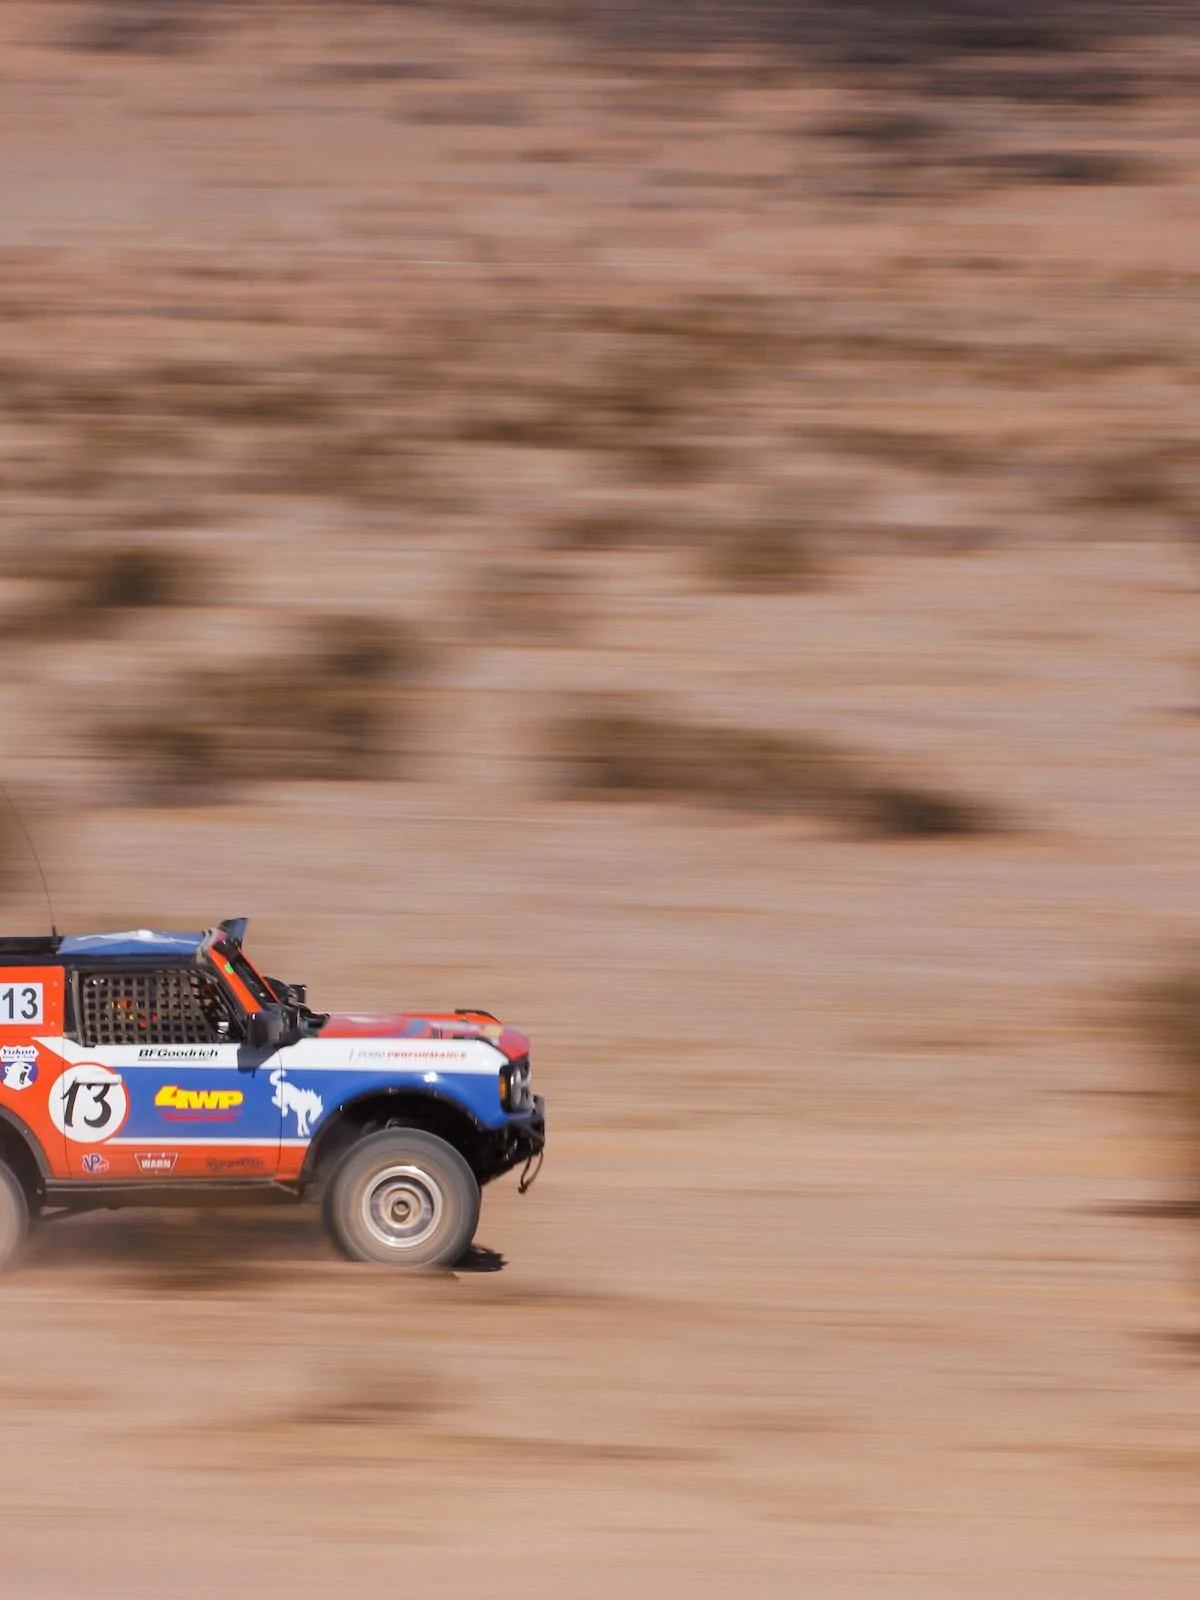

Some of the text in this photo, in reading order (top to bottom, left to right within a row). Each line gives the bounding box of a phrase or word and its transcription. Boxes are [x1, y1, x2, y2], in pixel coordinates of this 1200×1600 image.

[2, 988, 38, 1019] 13
[3, 1048, 35, 1056] Yukon
[139, 1048, 218, 1057] BFGoodrich
[61, 1079, 112, 1128] 13
[155, 1086, 244, 1109] 4WP
[83, 1154, 101, 1171] VP
[141, 1159, 171, 1169] WARN
